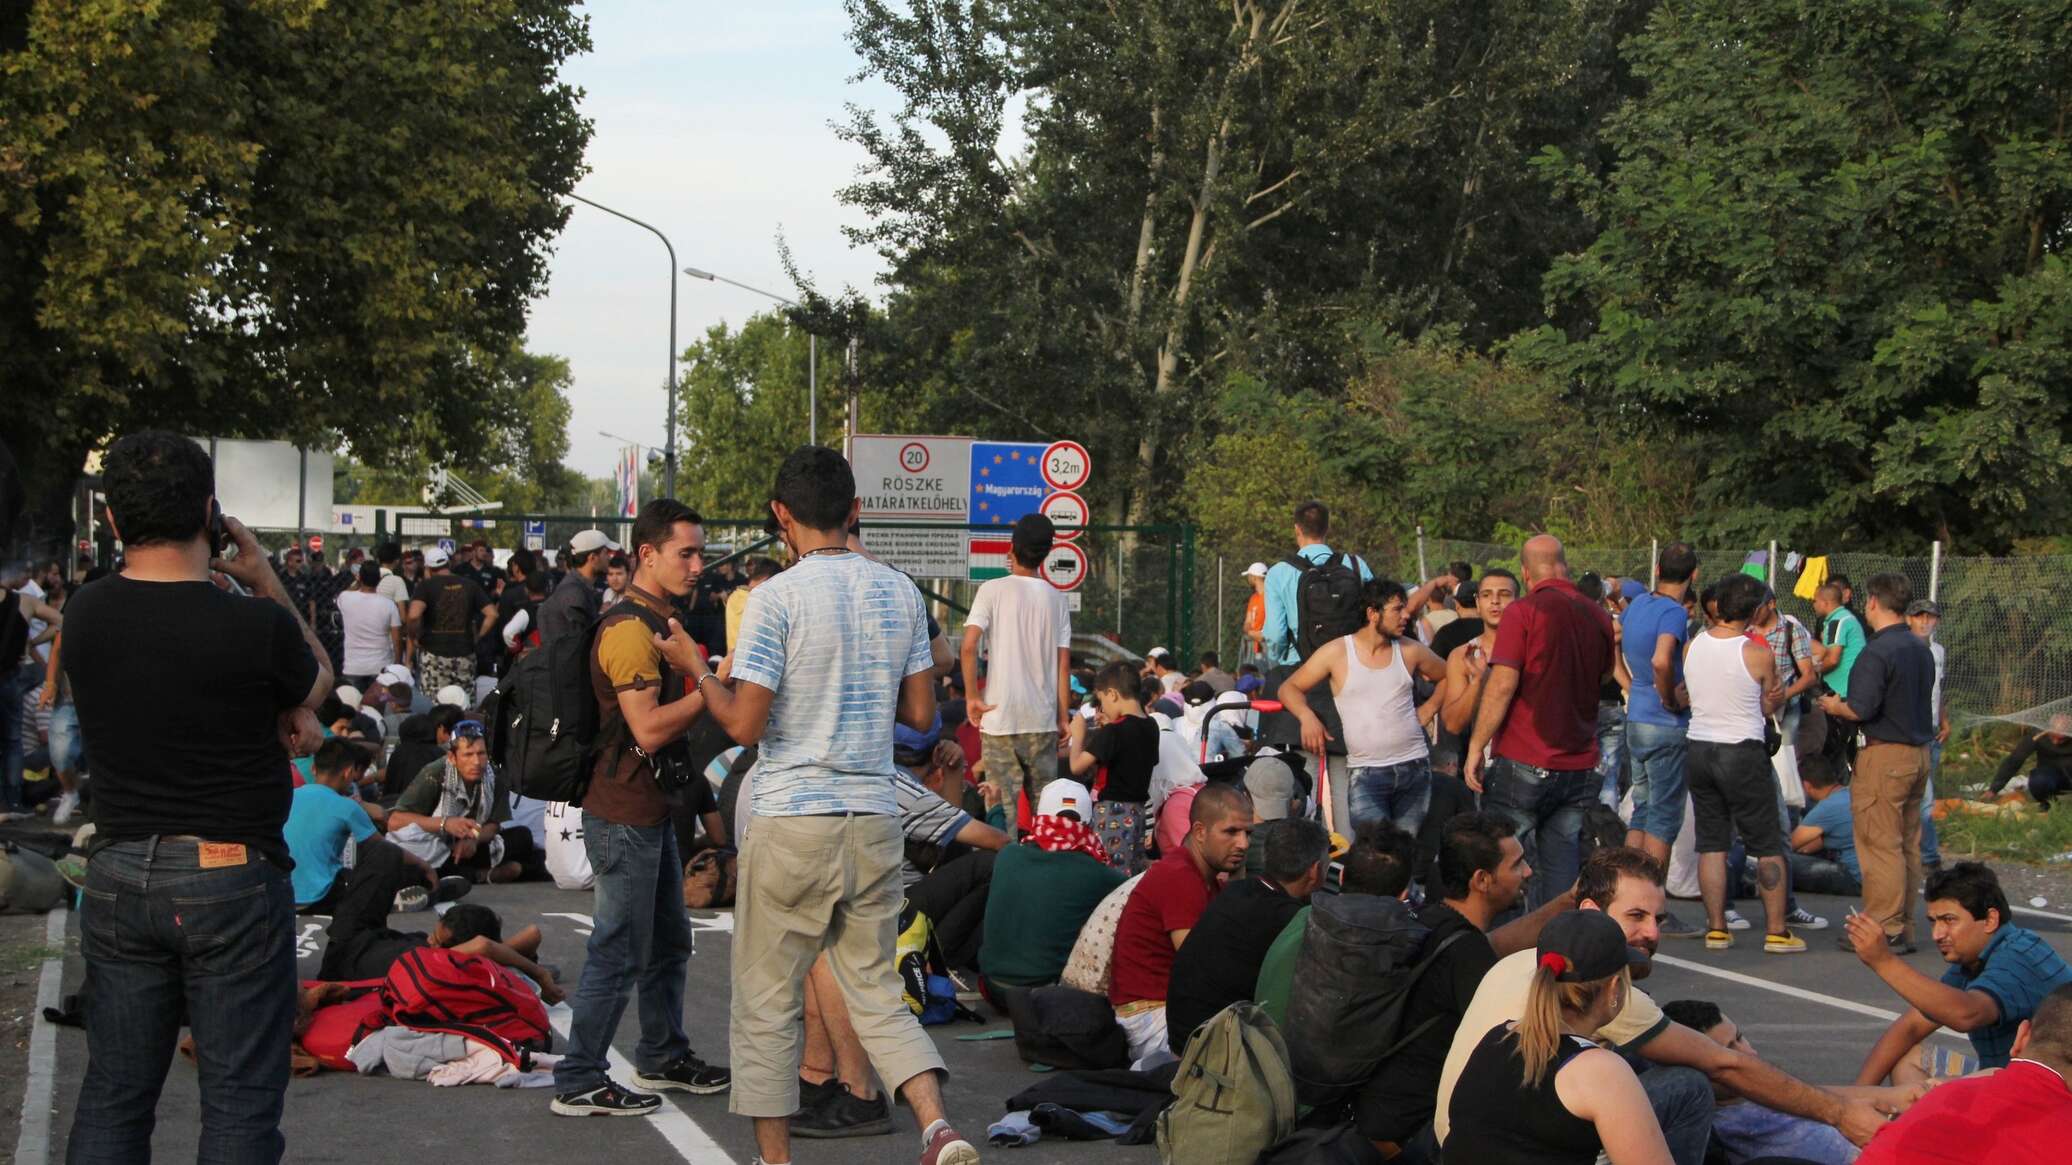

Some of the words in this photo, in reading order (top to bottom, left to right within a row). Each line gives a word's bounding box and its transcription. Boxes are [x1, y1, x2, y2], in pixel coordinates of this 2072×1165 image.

[907, 451, 923, 464] 20
[1051, 458, 1080, 475] 3,2m
[882, 475, 944, 491] RÖSZKE
[985, 484, 1042, 498] Magyarország
